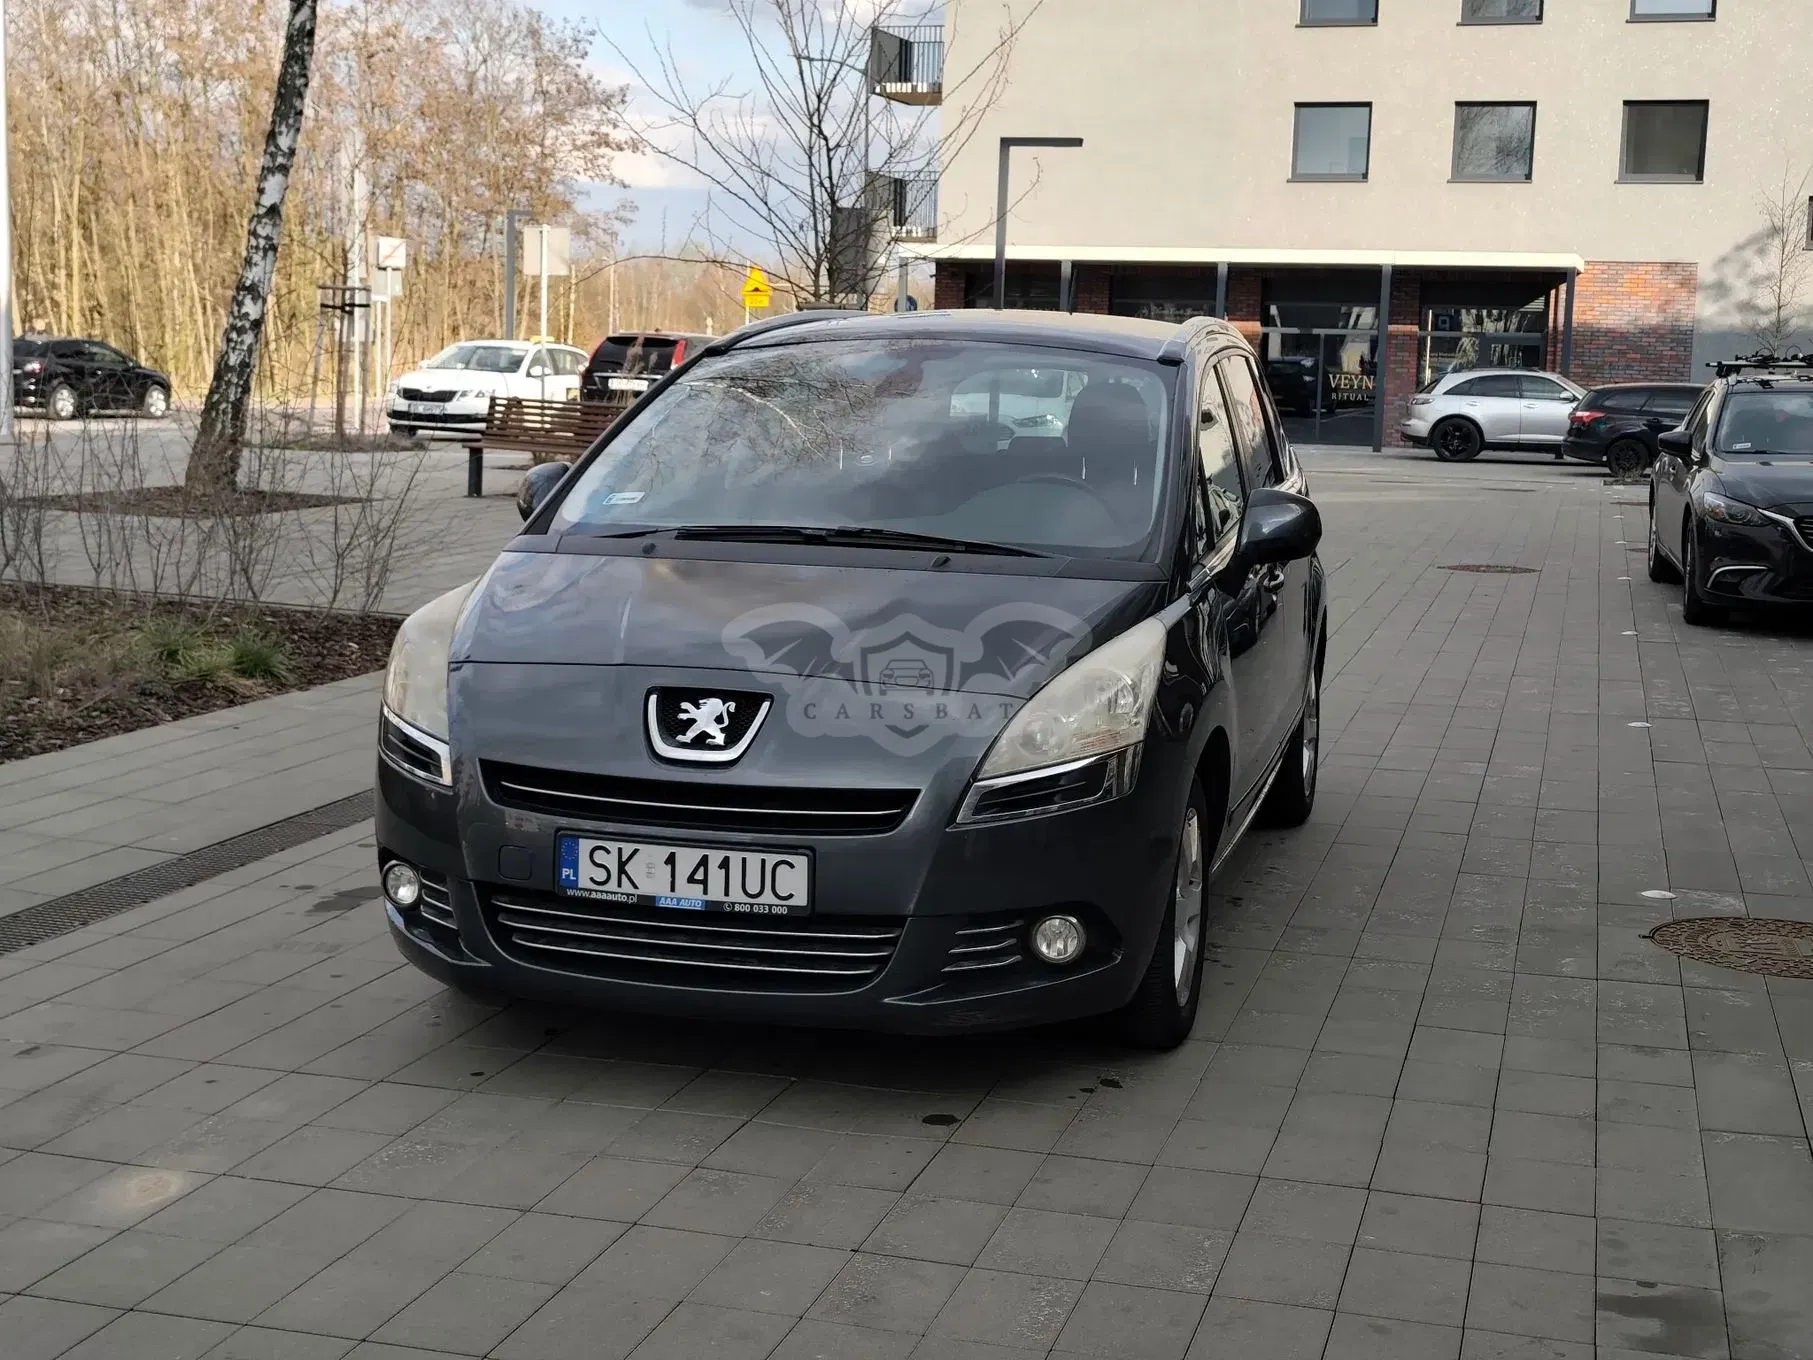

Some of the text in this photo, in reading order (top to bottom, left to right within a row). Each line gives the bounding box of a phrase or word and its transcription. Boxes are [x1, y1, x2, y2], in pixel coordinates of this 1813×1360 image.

[1328, 373, 1375, 390] VEYN
[1331, 392, 1369, 401] RITUAL
[562, 868, 577, 880] PL
[588, 845, 796, 901] SK 141UC
[566, 888, 638, 904] www.aaaauto.pl
[659, 897, 702, 908] AAA AUTO
[734, 903, 788, 915] 800 033 000
